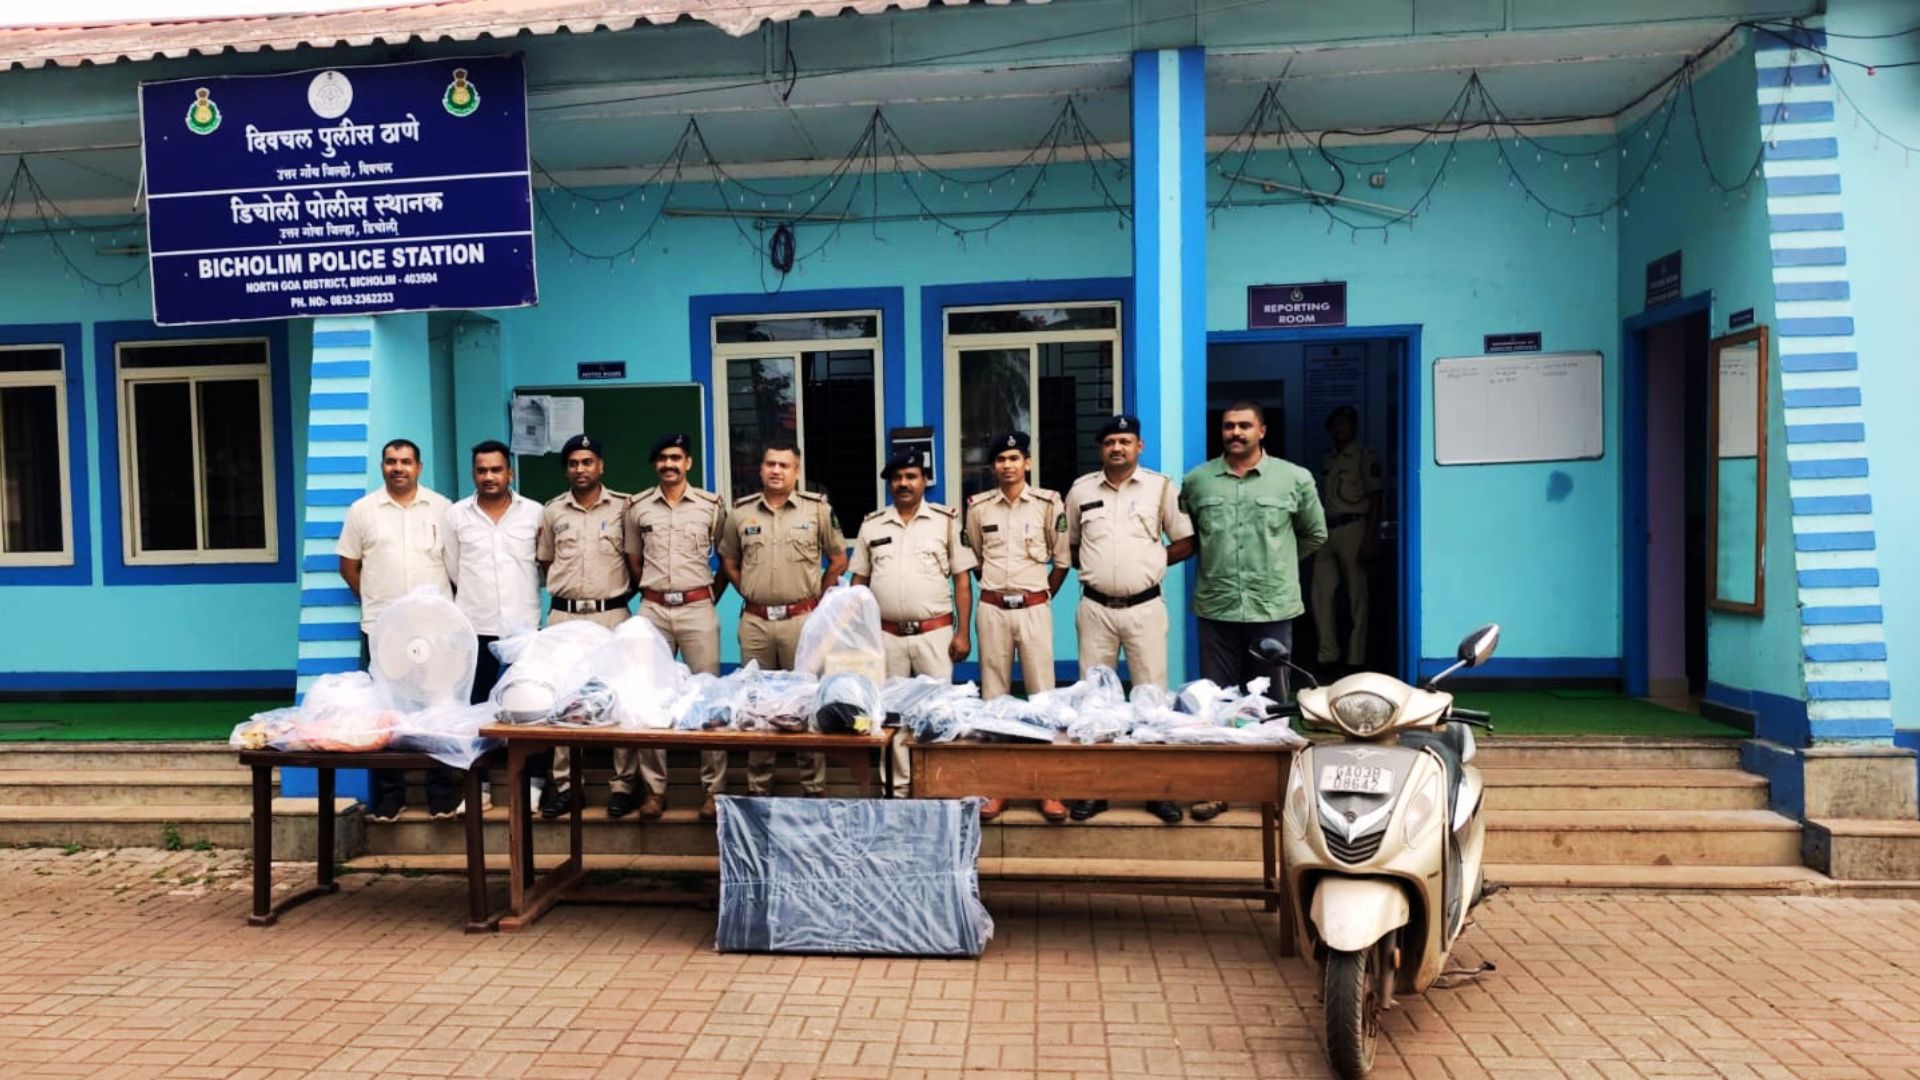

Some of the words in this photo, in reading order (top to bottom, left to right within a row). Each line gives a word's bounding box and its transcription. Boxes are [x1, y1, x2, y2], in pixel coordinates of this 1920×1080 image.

[245, 124, 312, 154] दिवचल
[318, 117, 375, 158] पुलीस
[380, 113, 420, 144] ठाणे
[358, 160, 393, 176] दिवचल
[230, 193, 300, 224] डिचोली
[305, 190, 368, 219] पोलीस
[373, 191, 444, 216] स्थानक
[198, 253, 302, 279] BICHOLIM
[309, 248, 386, 273] POLICE
[392, 242, 485, 268] STATION
[246, 281, 279, 293] NORTH
[281, 280, 301, 291] GOA
[303, 277, 348, 290] DISTRICT,
[350, 274, 397, 288] BICHOLIM
[404, 272, 438, 285] 403504
[291, 296, 306, 308] PH.
[1263, 302, 1331, 313] REPORTING
[1278, 314, 1316, 324] ROOM
